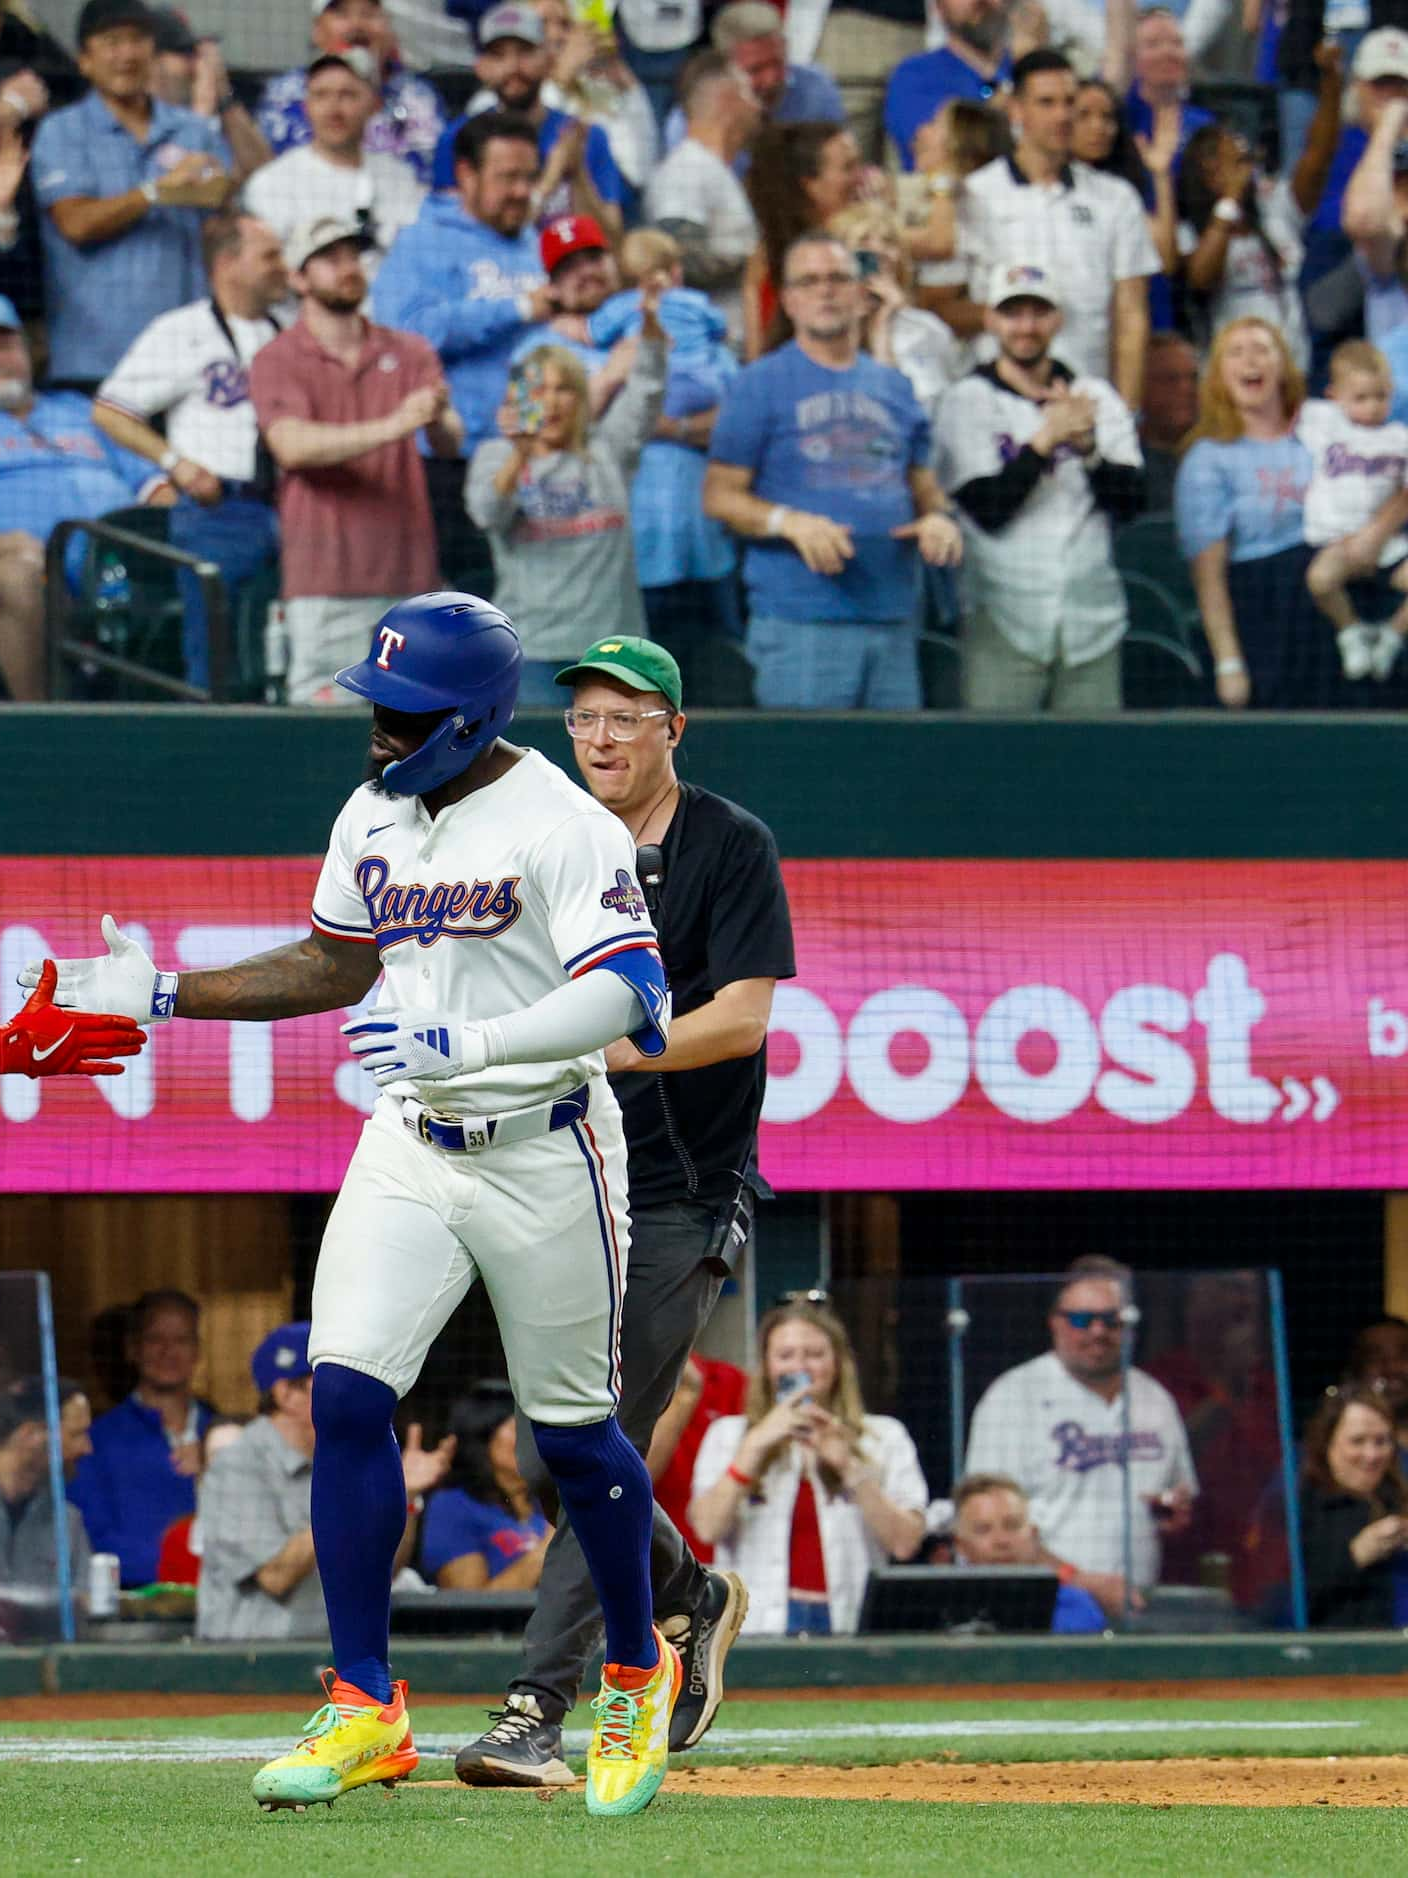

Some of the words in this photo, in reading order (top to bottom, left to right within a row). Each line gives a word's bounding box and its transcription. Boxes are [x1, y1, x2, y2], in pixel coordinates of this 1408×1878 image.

[377, 626, 405, 671] T
[354, 855, 522, 955] Rangers
[468, 1130, 485, 1146] 53
